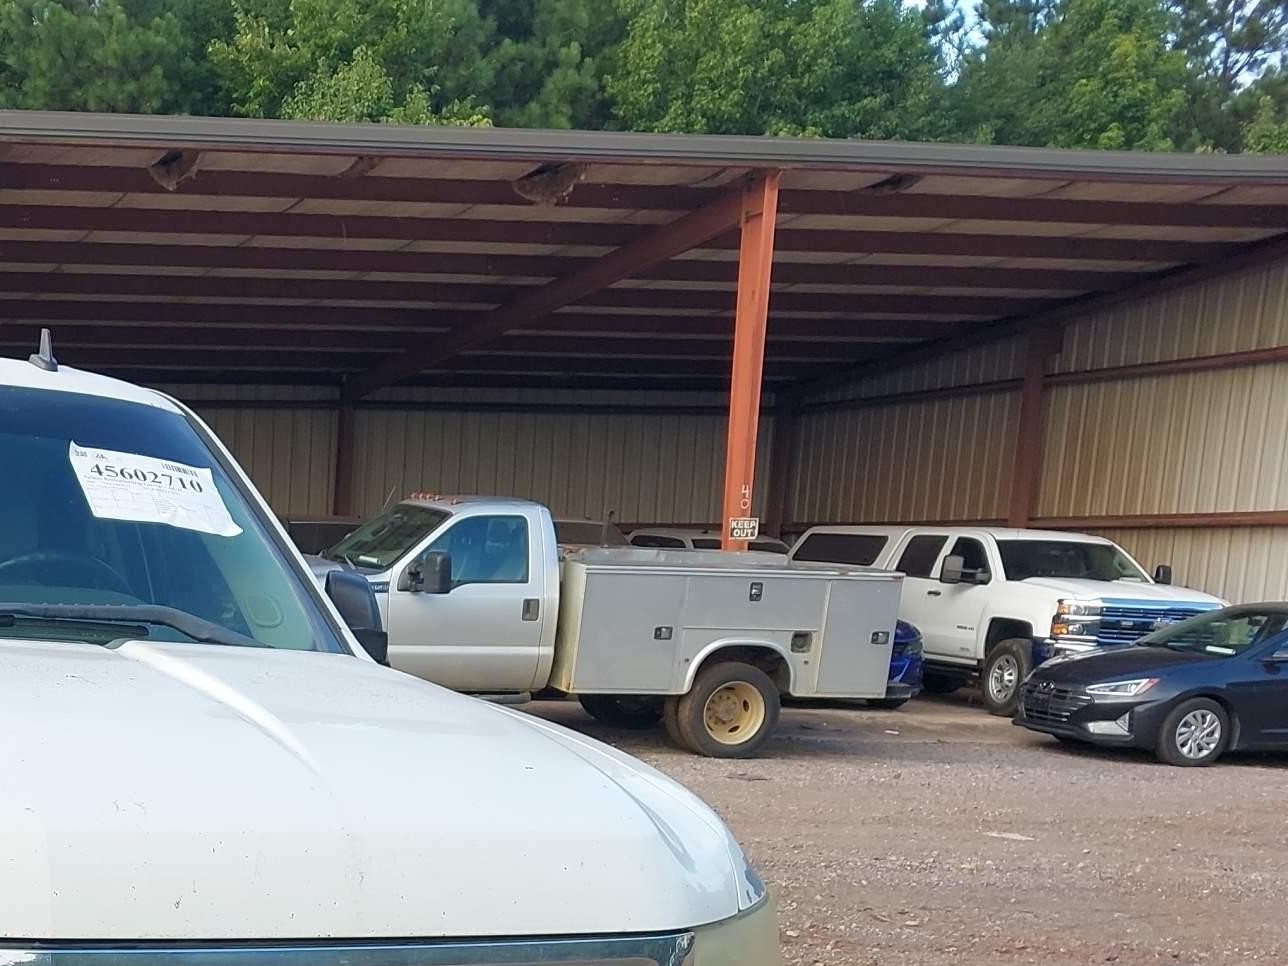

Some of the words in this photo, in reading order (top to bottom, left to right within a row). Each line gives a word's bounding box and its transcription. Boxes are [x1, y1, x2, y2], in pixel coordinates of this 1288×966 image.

[90, 463, 204, 493] 45602710
[731, 520, 756, 529] KEEP
[733, 528, 754, 537] OUT
